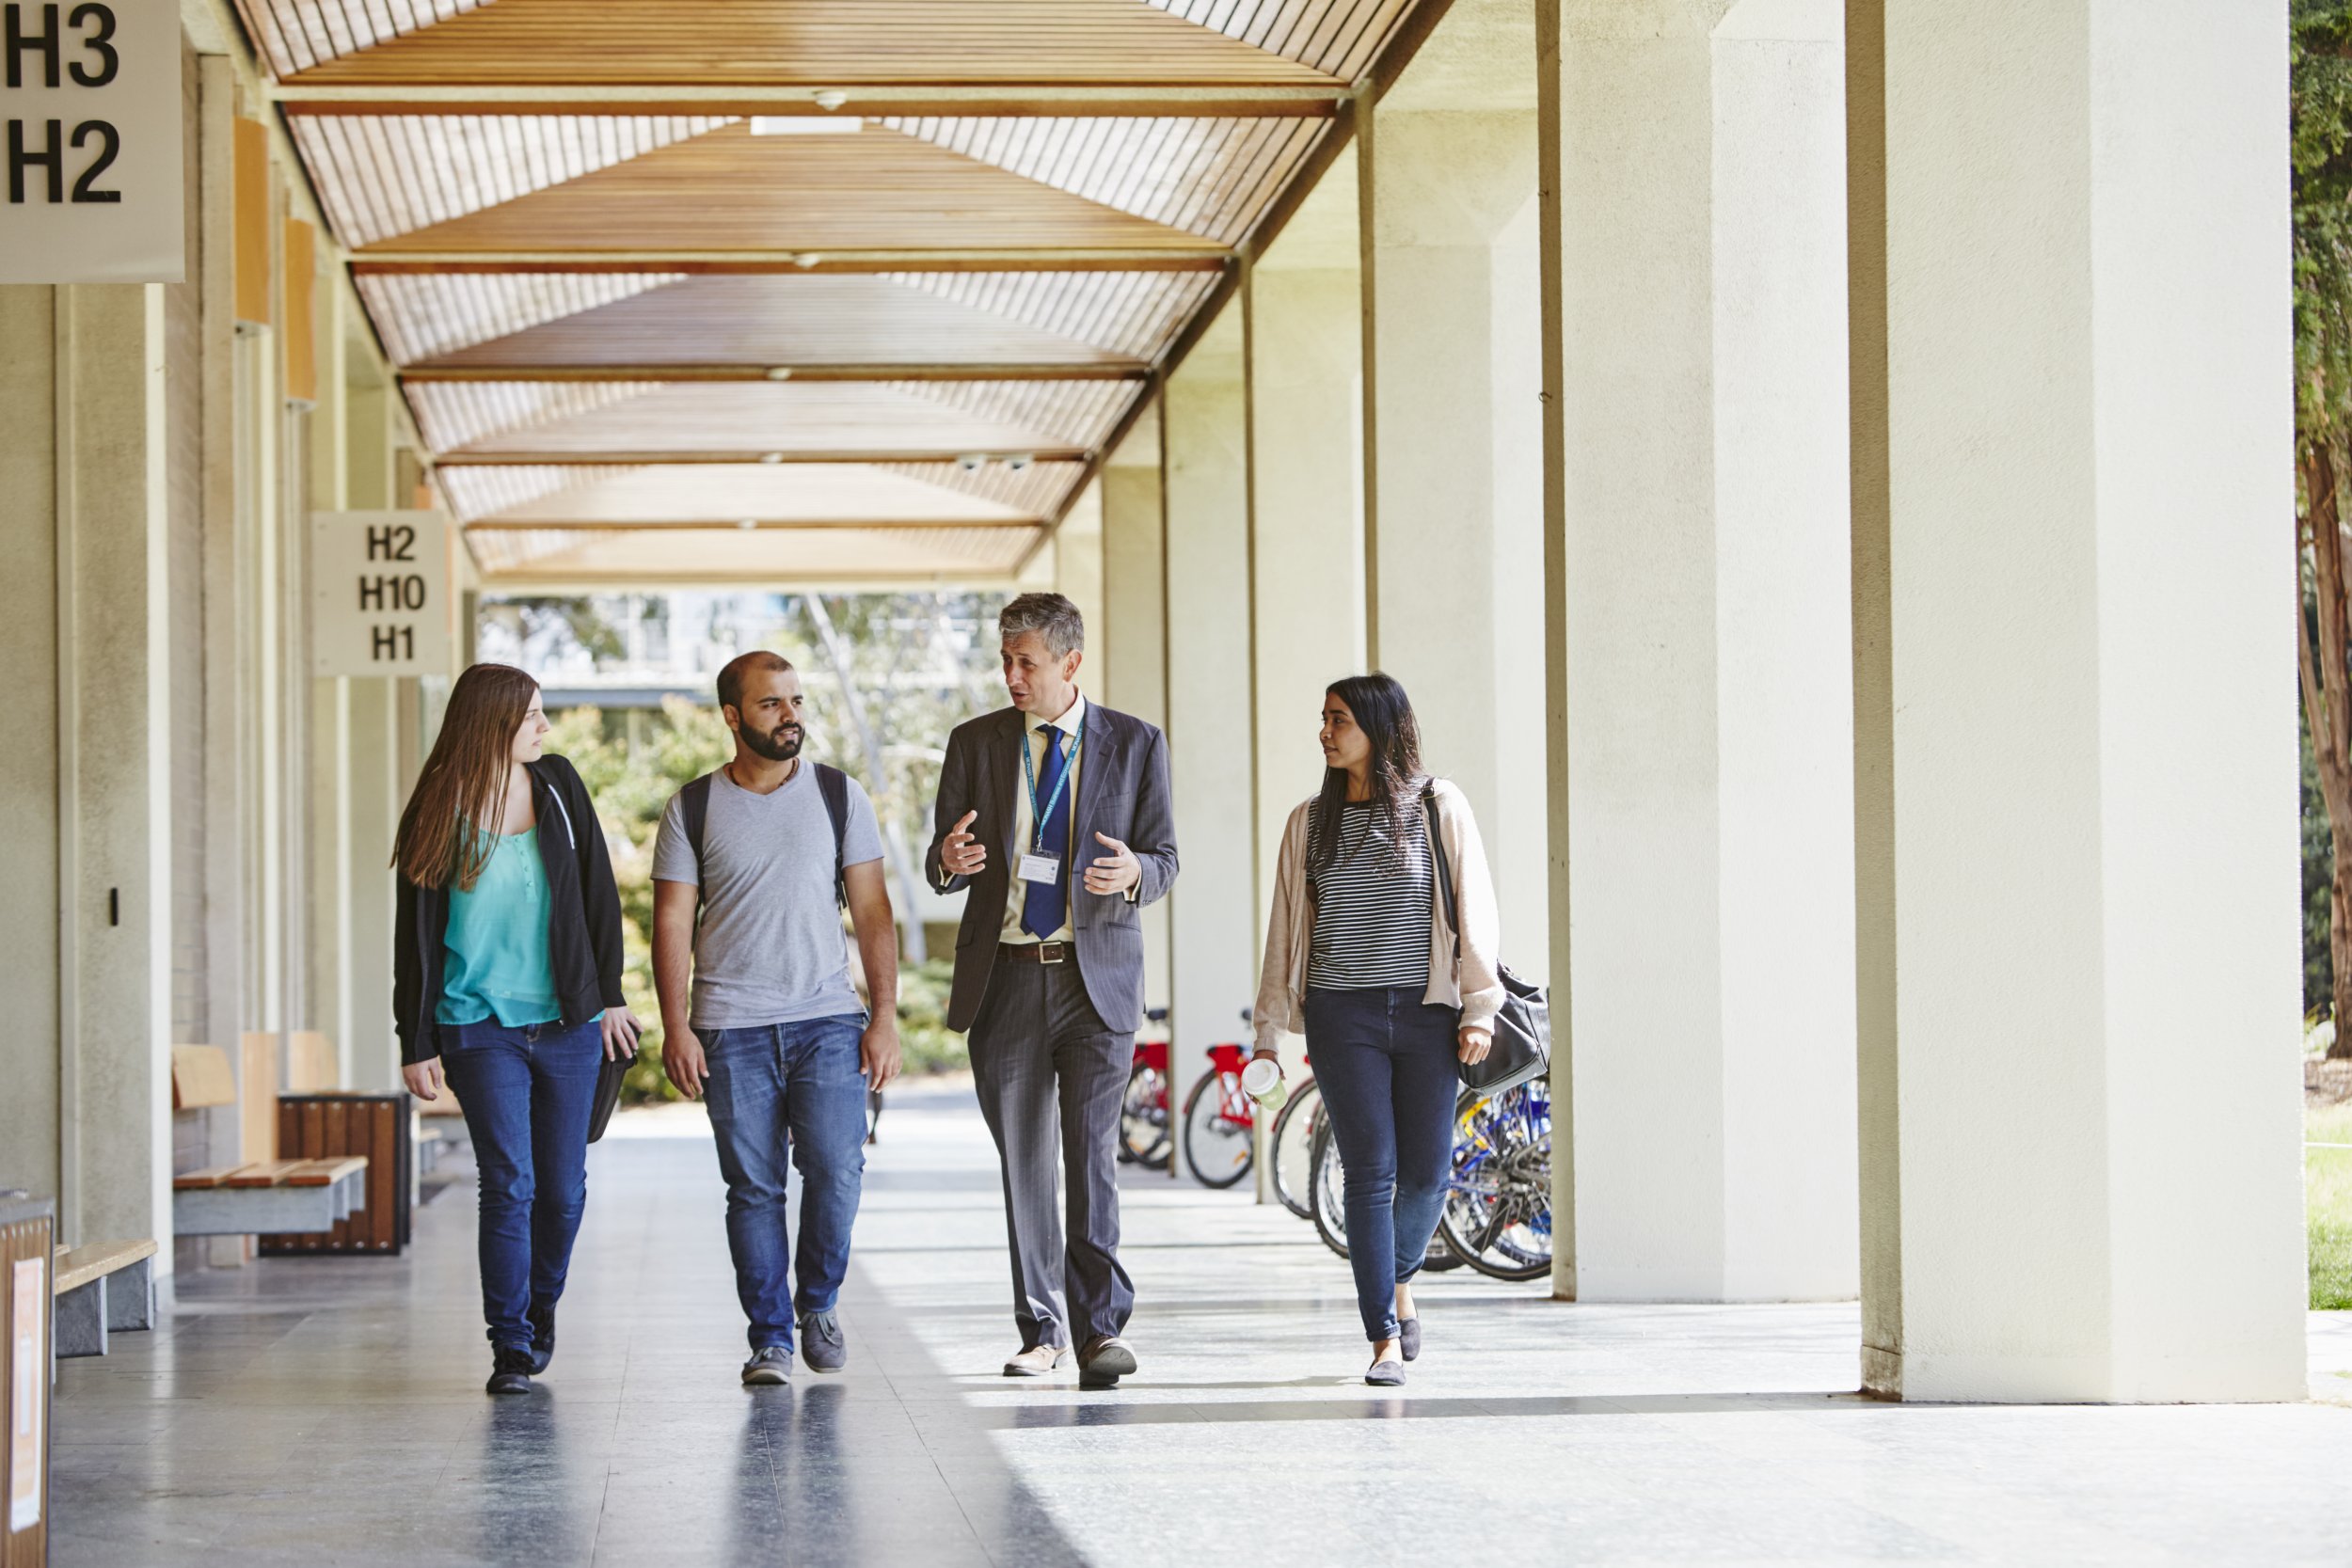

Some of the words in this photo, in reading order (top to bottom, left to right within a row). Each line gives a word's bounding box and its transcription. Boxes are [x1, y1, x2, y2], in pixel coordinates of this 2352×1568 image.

[5, 3, 119, 88] H3
[8, 119, 121, 203] H2
[367, 525, 416, 562] H2
[358, 575, 426, 610] H10
[372, 626, 413, 660] H1
